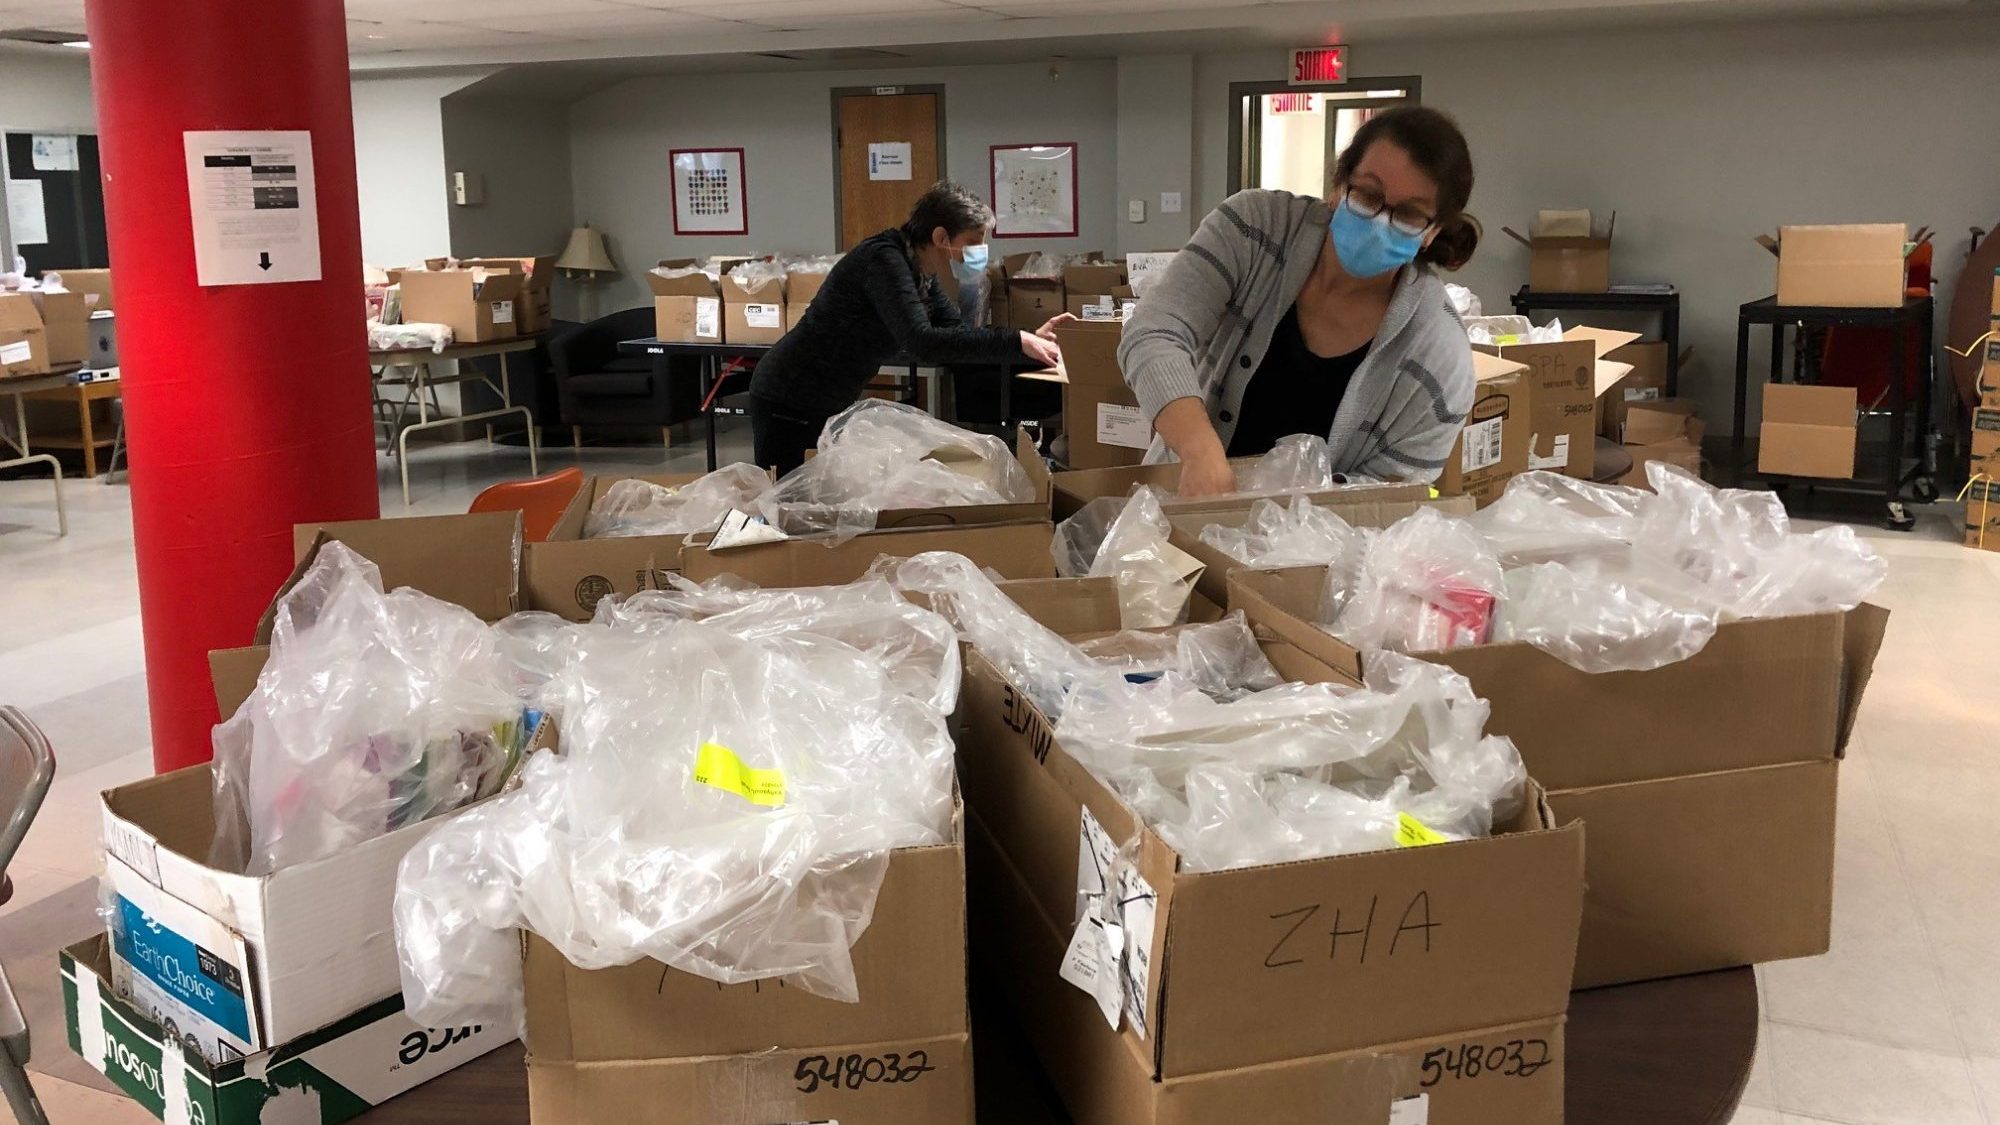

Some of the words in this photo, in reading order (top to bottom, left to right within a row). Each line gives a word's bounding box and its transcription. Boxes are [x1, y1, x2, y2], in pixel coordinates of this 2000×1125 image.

[1295, 49, 1343, 81] SORTIE
[1264, 890, 1443, 968] ZHA
[132, 929, 216, 1006] EarthChoice
[794, 1050, 936, 1094] 548032
[1419, 1039, 1553, 1087] 548032
